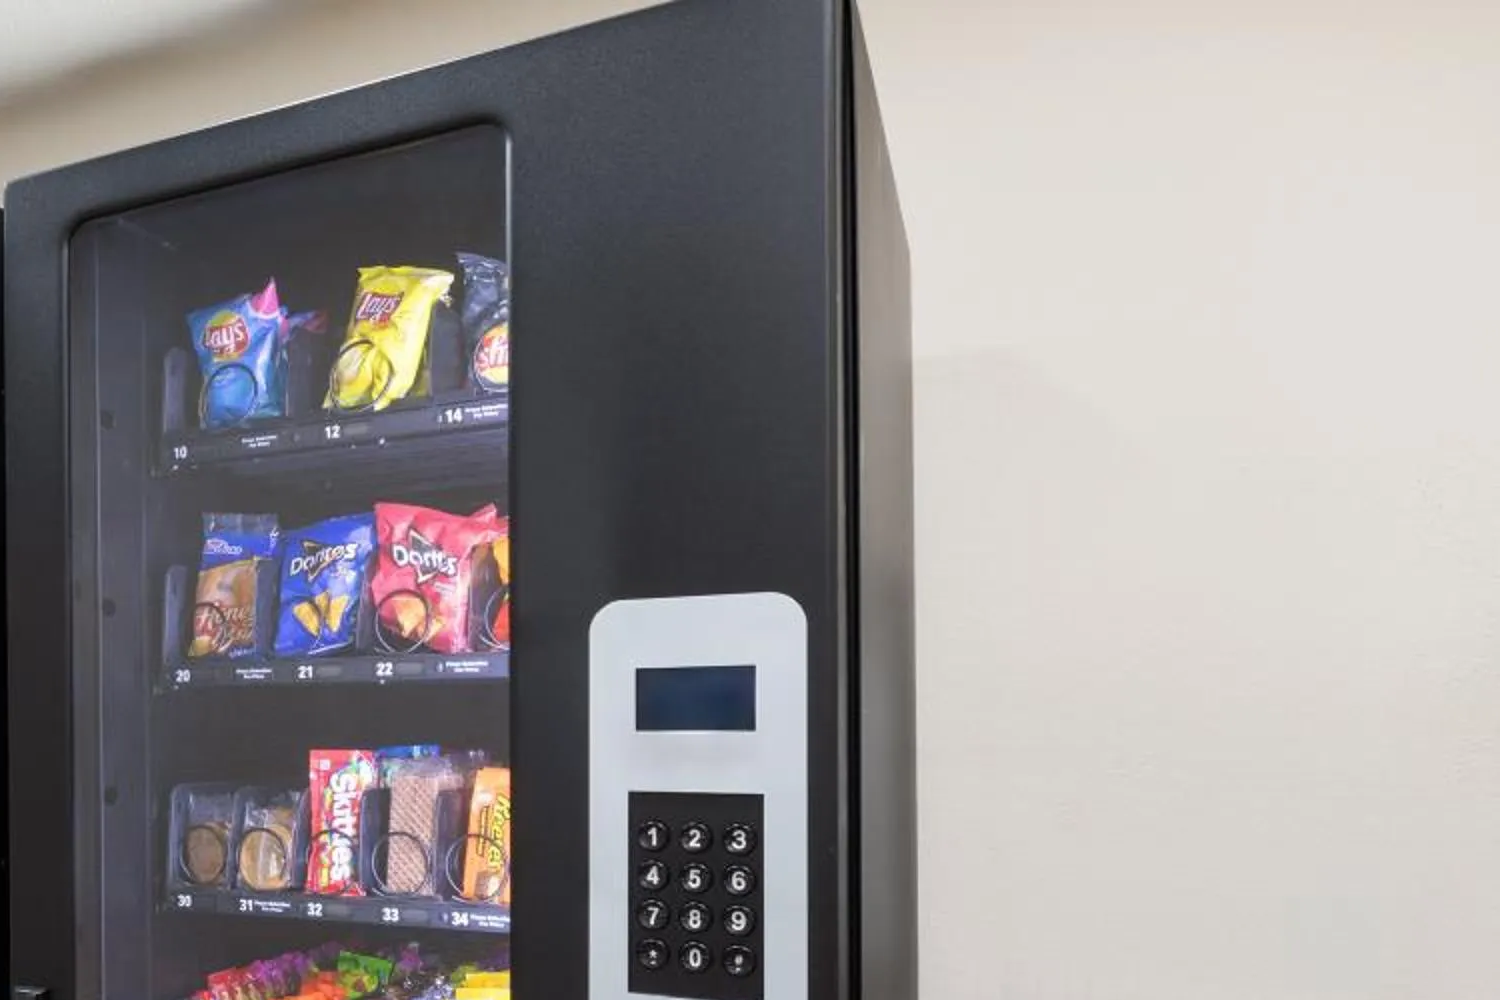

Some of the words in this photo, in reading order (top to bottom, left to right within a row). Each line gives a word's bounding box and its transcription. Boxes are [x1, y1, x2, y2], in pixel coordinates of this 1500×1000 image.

[445, 407, 463, 423] 14
[325, 424, 341, 439] 12
[173, 445, 188, 459] 10
[393, 546, 458, 576] Doritos
[175, 669, 191, 683] 20
[297, 665, 313, 679] 21
[375, 661, 393, 677] 22
[647, 827, 657, 847] 1
[688, 829, 701, 848] 2
[731, 829, 747, 851] 3
[645, 865, 660, 885] 4
[687, 869, 701, 889] 5
[731, 871, 746, 891] 6
[177, 894, 192, 908] 30
[239, 898, 253, 912] 31
[307, 902, 323, 917] 32
[382, 907, 400, 922] 33
[451, 911, 469, 927] 34
[648, 906, 659, 926] 7
[688, 909, 702, 929] 8
[731, 911, 747, 931] 9
[688, 948, 702, 968] 0
